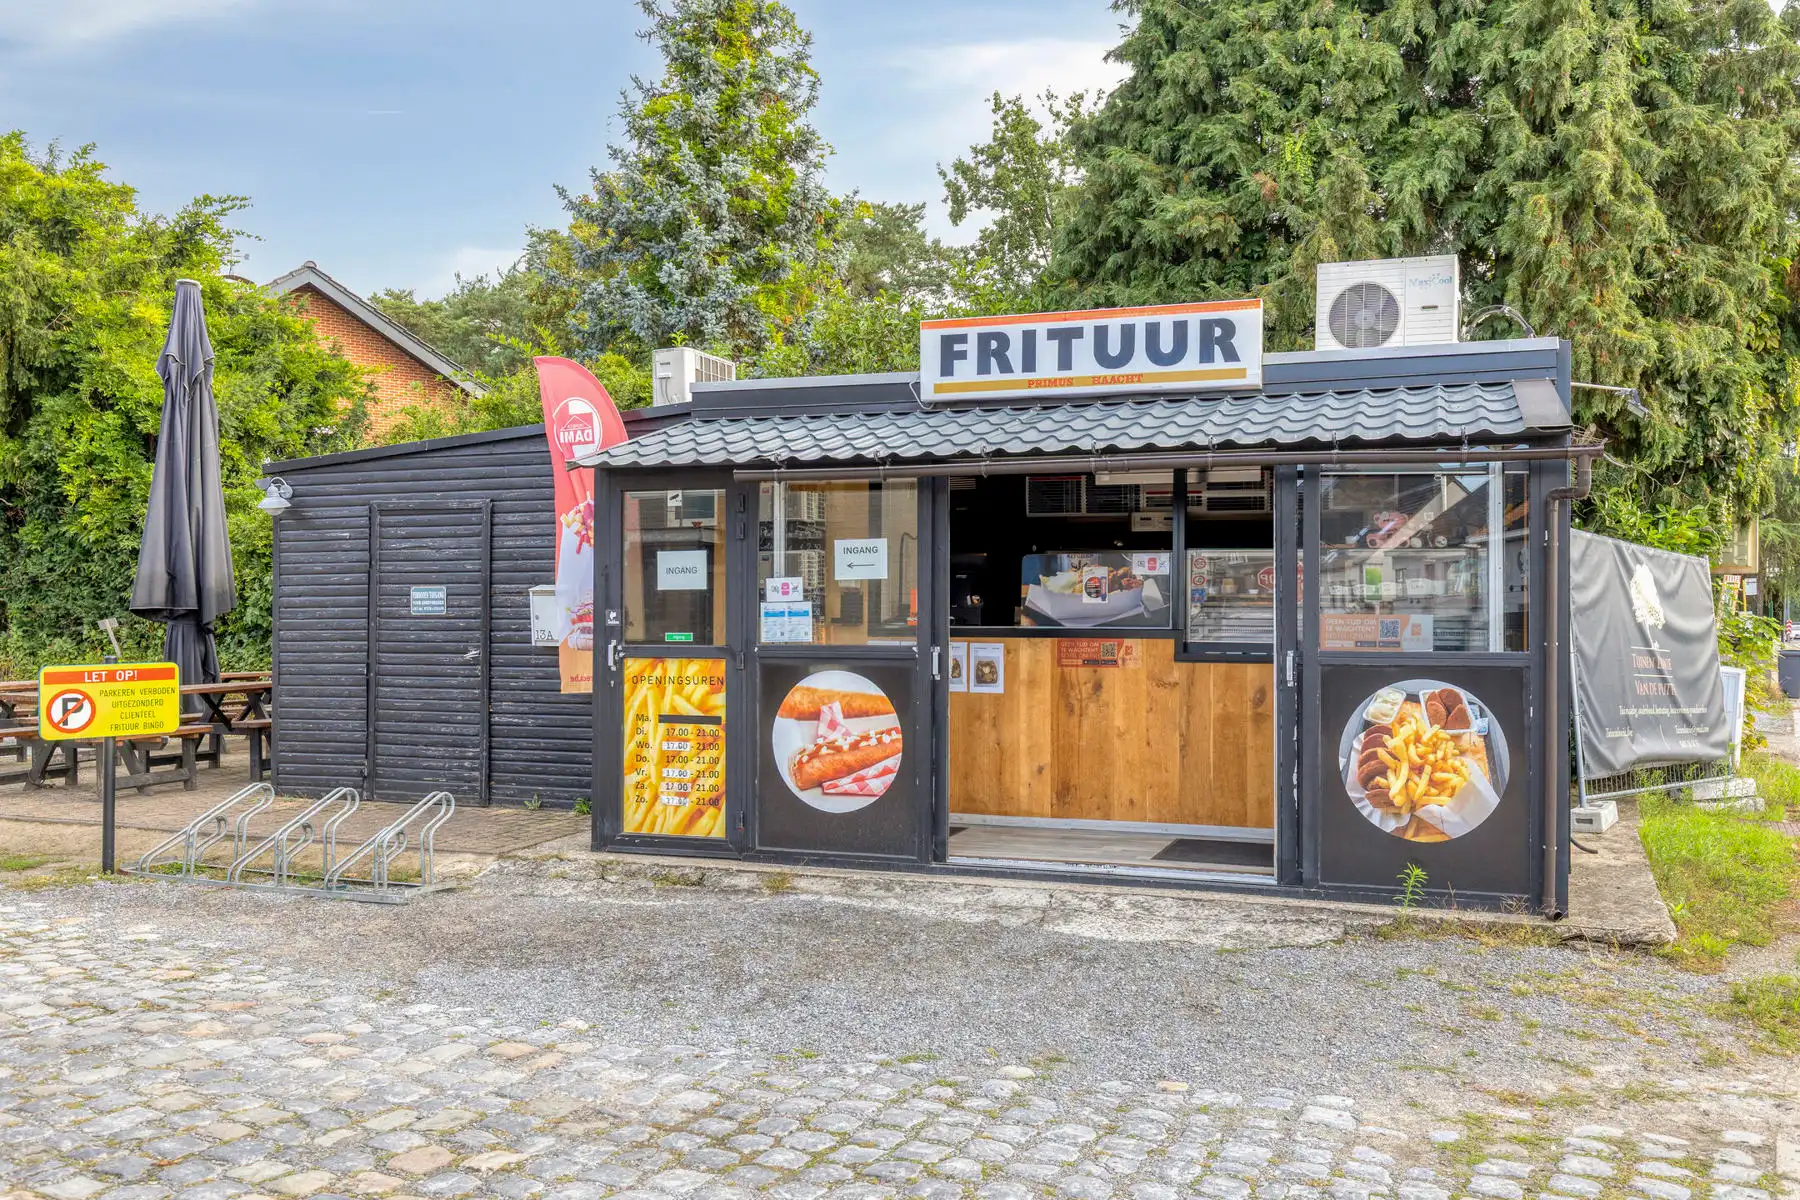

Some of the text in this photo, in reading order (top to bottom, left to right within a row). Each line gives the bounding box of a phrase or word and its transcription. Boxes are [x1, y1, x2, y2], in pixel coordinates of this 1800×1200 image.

[939, 317, 1241, 378] FRITUUR
[1027, 374, 1144, 388] PRIMUS HAACHT
[843, 546, 879, 555] INGANG
[665, 567, 698, 576] INGANG
[535, 629, 554, 640] 13A
[84, 670, 137, 682] LET OP!
[632, 675, 725, 686] OPENINGSUREN
[99, 687, 175, 697] PARKEREN VERBODEN
[112, 699, 164, 708] UITGEZONDERD
[120, 711, 156, 719] CLIENTEEL
[635, 714, 652, 722] Ma.
[110, 723, 139, 731] FRITUUR
[636, 727, 647, 735] Di.
[666, 728, 689, 736] 17.00
[696, 728, 720, 736] 21.00
[636, 741, 653, 749] Wo.
[666, 742, 689, 750] 17.00
[696, 743, 720, 751] 21.00
[635, 755, 650, 763] Do.
[666, 756, 689, 764] 17.00
[696, 757, 720, 765] 21.00
[635, 768, 648, 776] Vr.
[666, 770, 689, 778] 17.00
[696, 771, 720, 779] 21.00
[635, 782, 648, 790] Za.
[696, 785, 720, 793] 21.00
[635, 795, 648, 804] Zo.
[696, 798, 720, 806] 21.00
